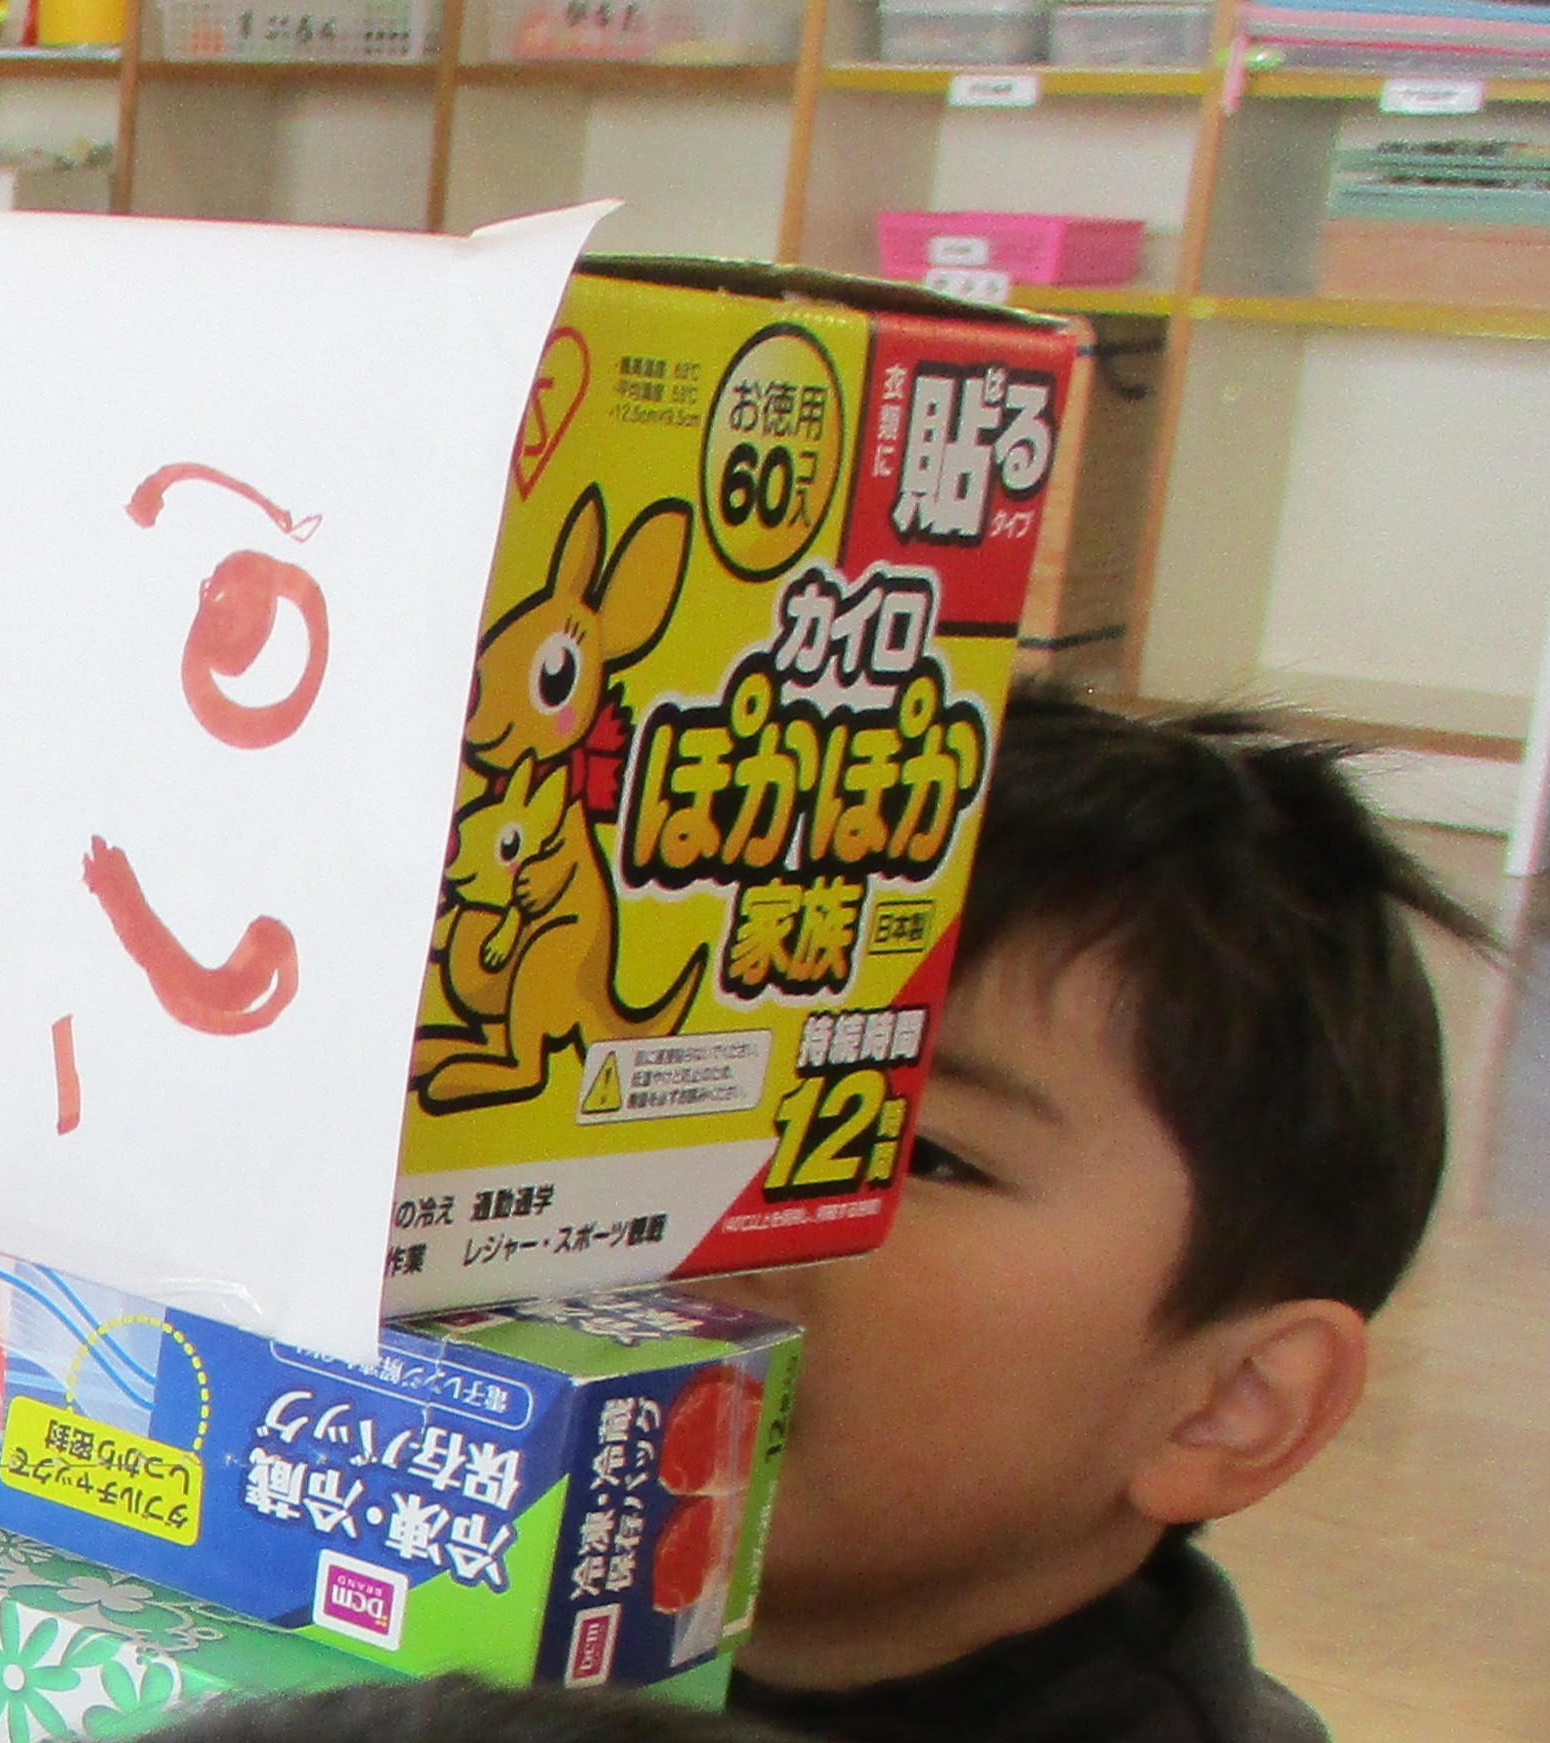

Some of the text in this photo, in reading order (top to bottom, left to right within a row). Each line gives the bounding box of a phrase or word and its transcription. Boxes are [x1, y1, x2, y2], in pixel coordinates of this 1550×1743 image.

[729, 378, 828, 441] お徳用
[892, 372, 1051, 537] 貼る
[989, 508, 1036, 539] タイプ
[777, 583, 929, 674] カイロ
[633, 674, 981, 870] ぽかぽか
[727, 876, 865, 986] 家族
[874, 909, 926, 946] 日本製
[797, 1008, 926, 1069] 持続時間
[7, 1456, 193, 1532] ダブルチャックで
[46, 1419, 193, 1494] しっかり密封
[252, 1388, 524, 1512] 保存バッグ
[605, 1397, 663, 1593] 保存バッグ
[245, 1457, 513, 1591] 冷凍・冷蔵
[571, 1396, 638, 1602] 冷凍・冷蔵
[337, 1575, 383, 1596] BRAND
